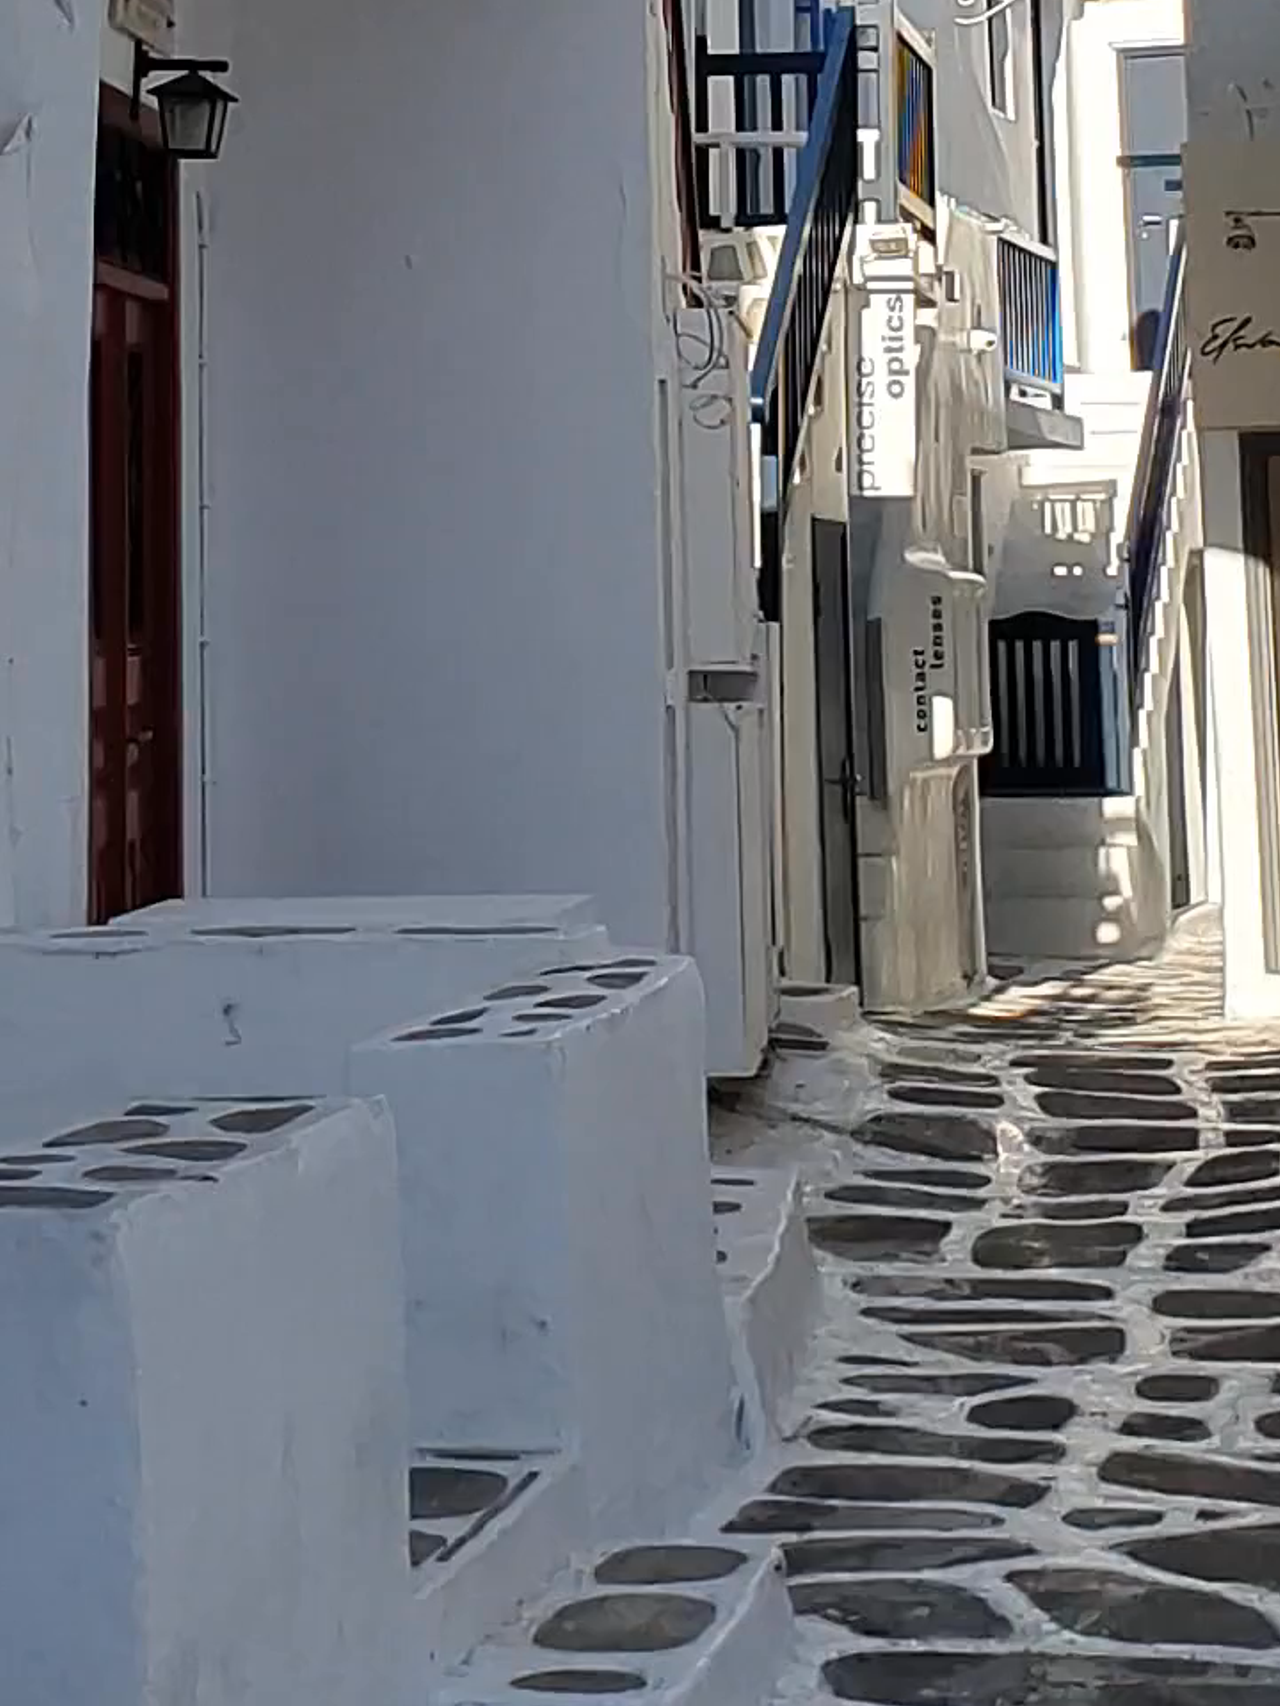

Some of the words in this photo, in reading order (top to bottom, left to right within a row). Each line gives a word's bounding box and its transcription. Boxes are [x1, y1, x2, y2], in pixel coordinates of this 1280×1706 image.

[881, 293, 910, 400] optics
[856, 356, 881, 491] precise
[929, 595, 945, 669] lenses
[913, 648, 928, 733] contact
